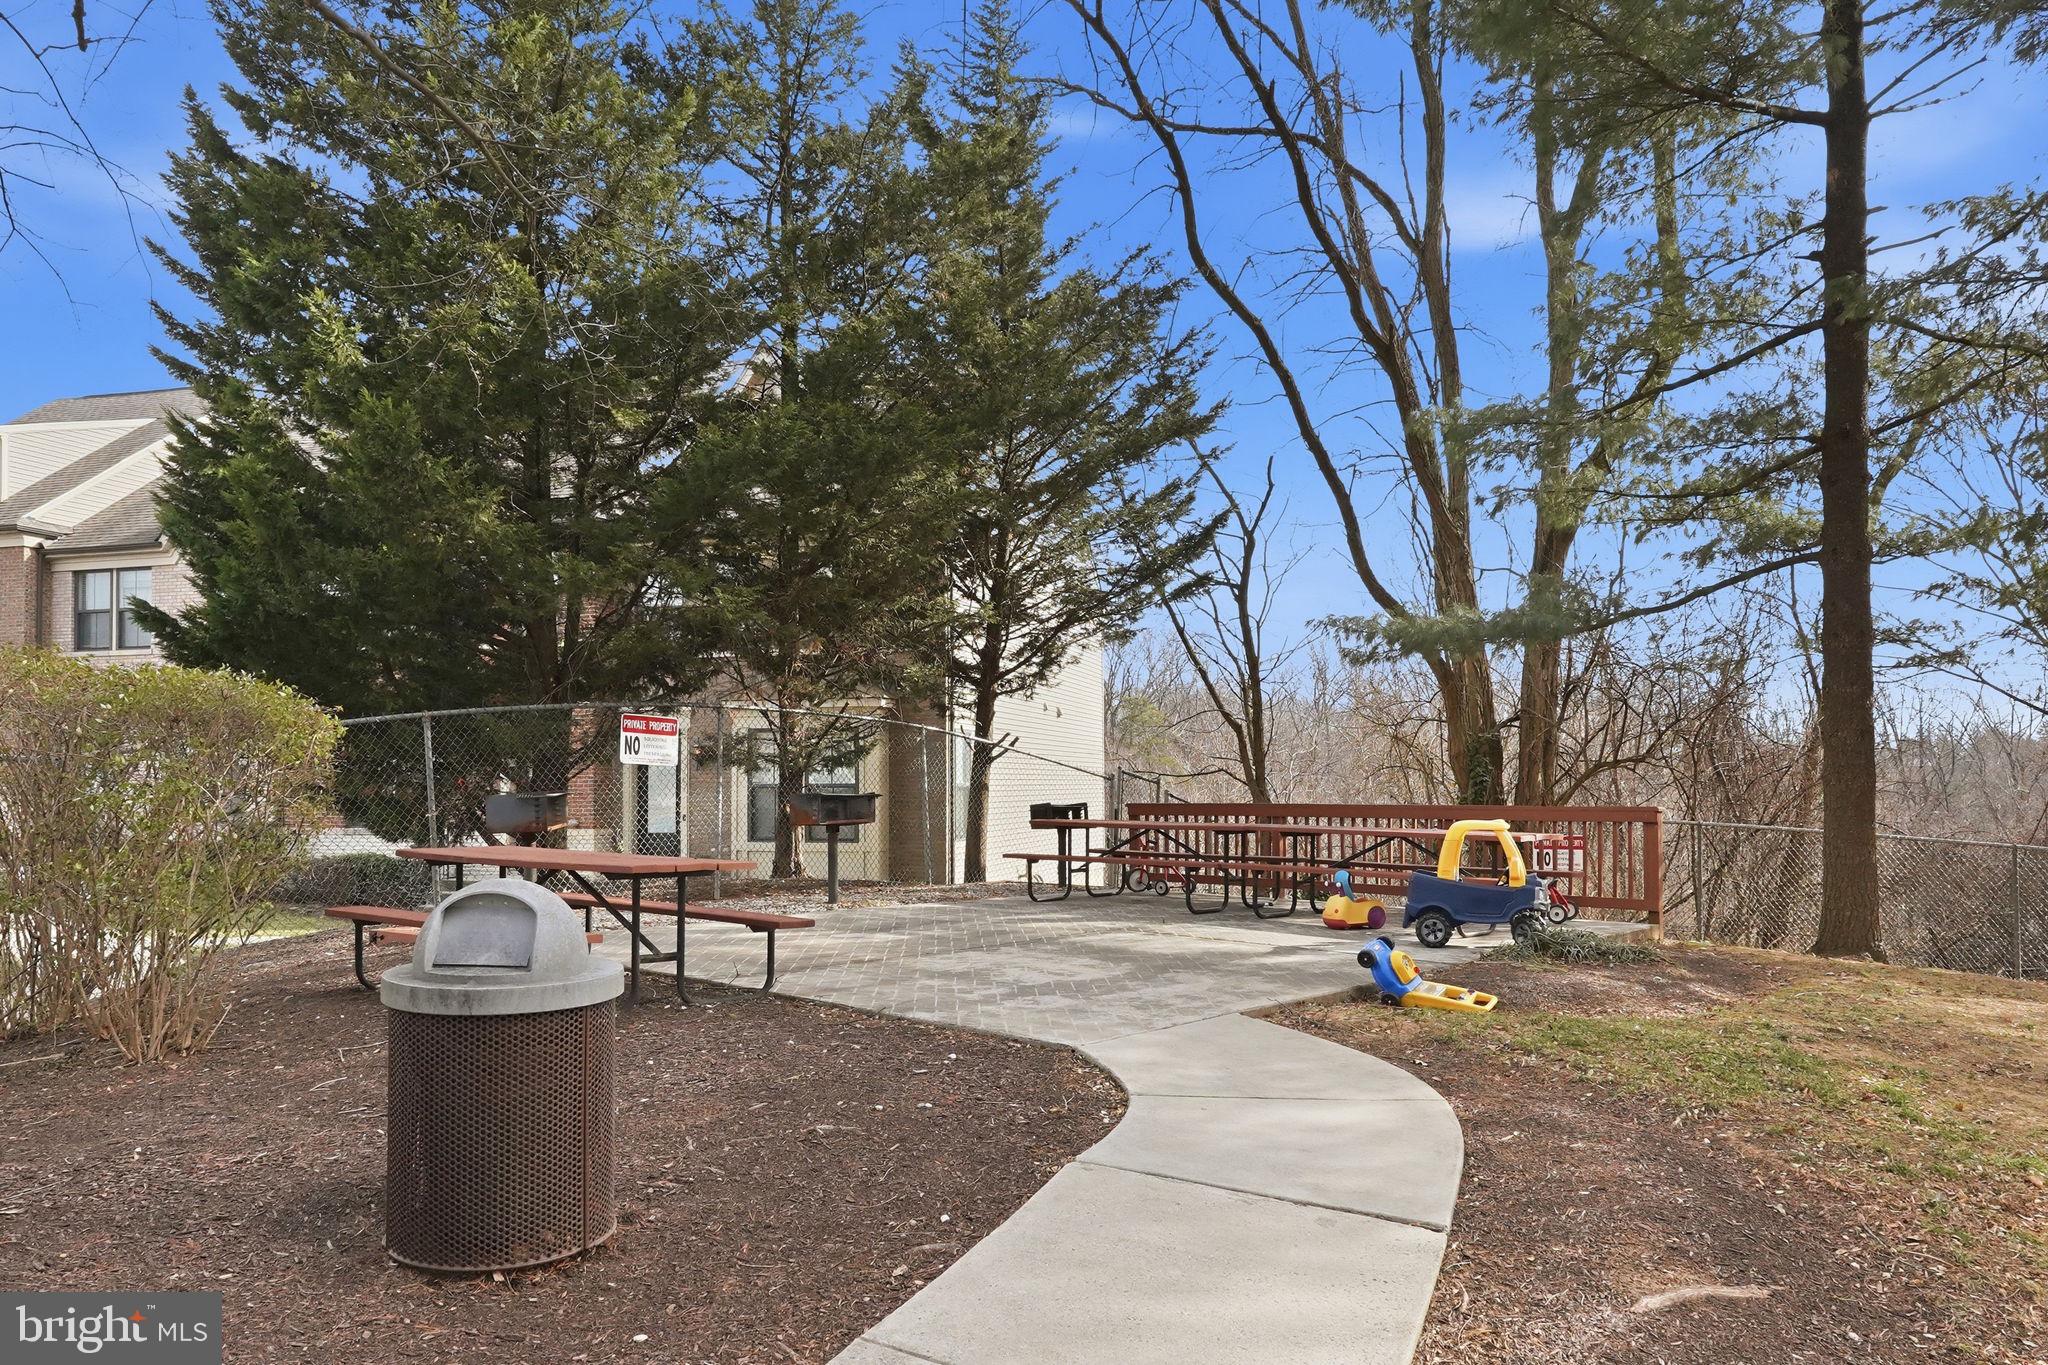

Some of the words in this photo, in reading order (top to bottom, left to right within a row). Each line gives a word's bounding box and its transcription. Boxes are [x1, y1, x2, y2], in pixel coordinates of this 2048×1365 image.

[624, 719, 647, 730] PRIVATE
[649, 721, 676, 732] PROPERTY
[624, 735, 641, 755] NO
